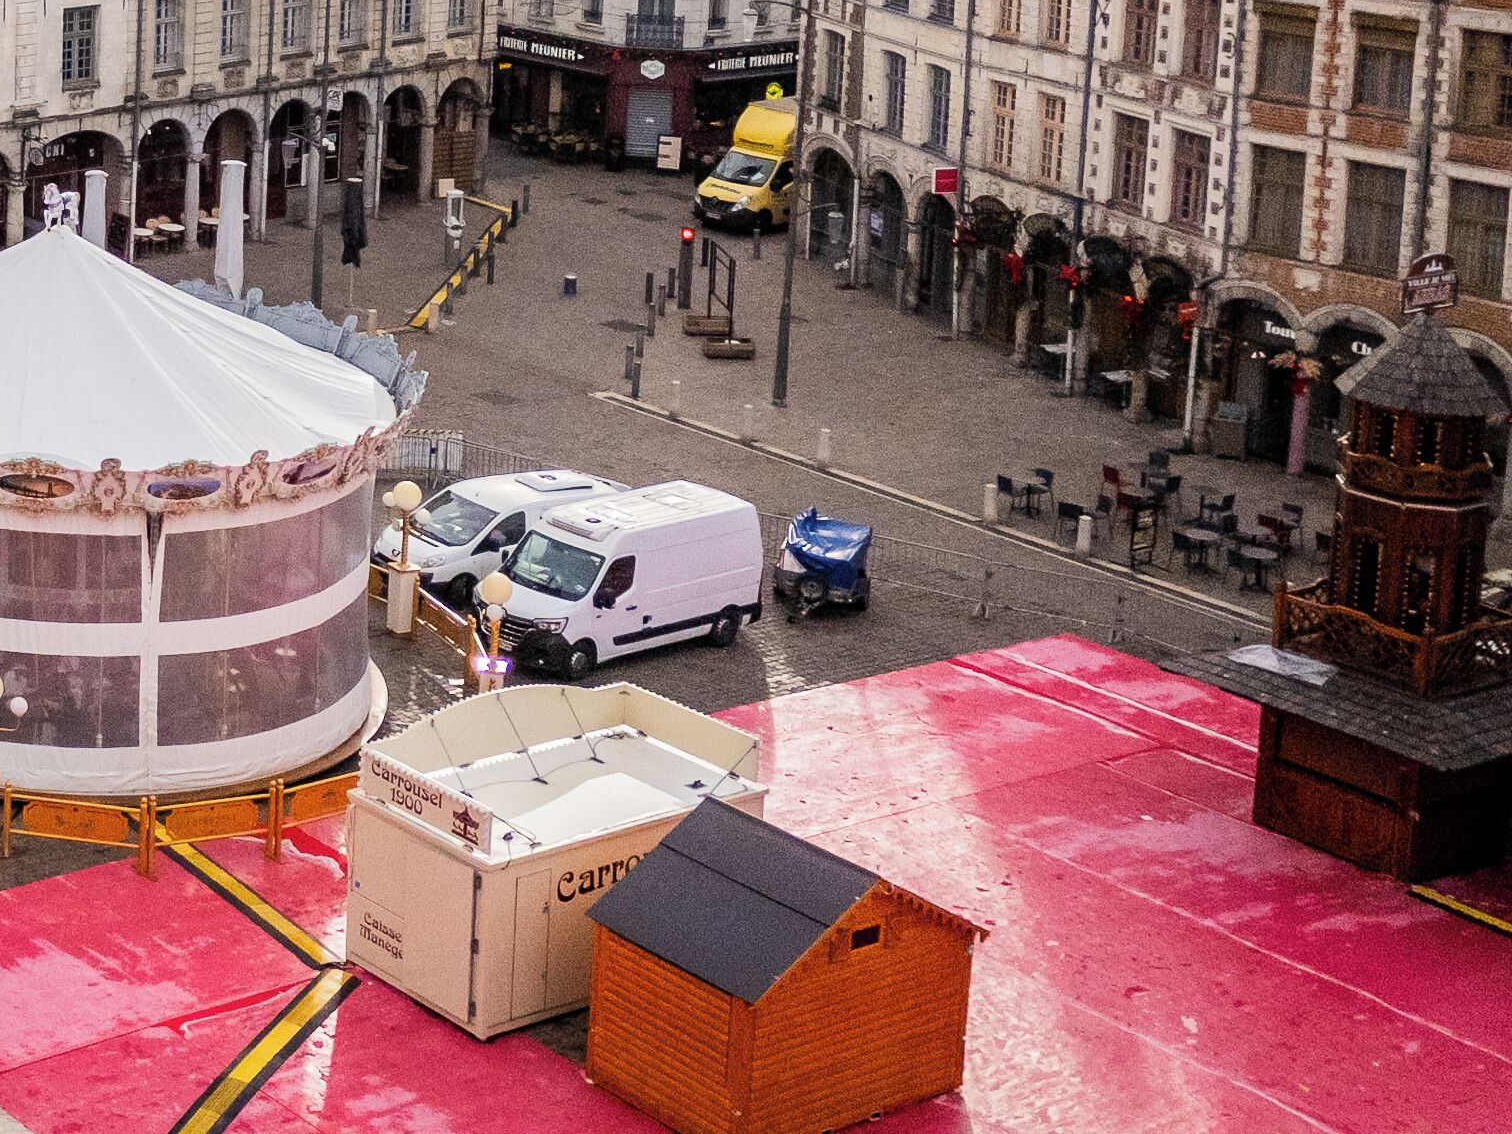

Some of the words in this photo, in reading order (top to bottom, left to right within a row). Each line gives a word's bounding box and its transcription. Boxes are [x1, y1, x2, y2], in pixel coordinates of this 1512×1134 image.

[530, 42, 576, 61] MEUNIER
[749, 52, 794, 68] MEUNIER
[371, 759, 443, 809] Carrousel
[390, 787, 423, 815] 1900
[557, 852, 649, 903] Carro
[364, 912, 403, 943] Caisse
